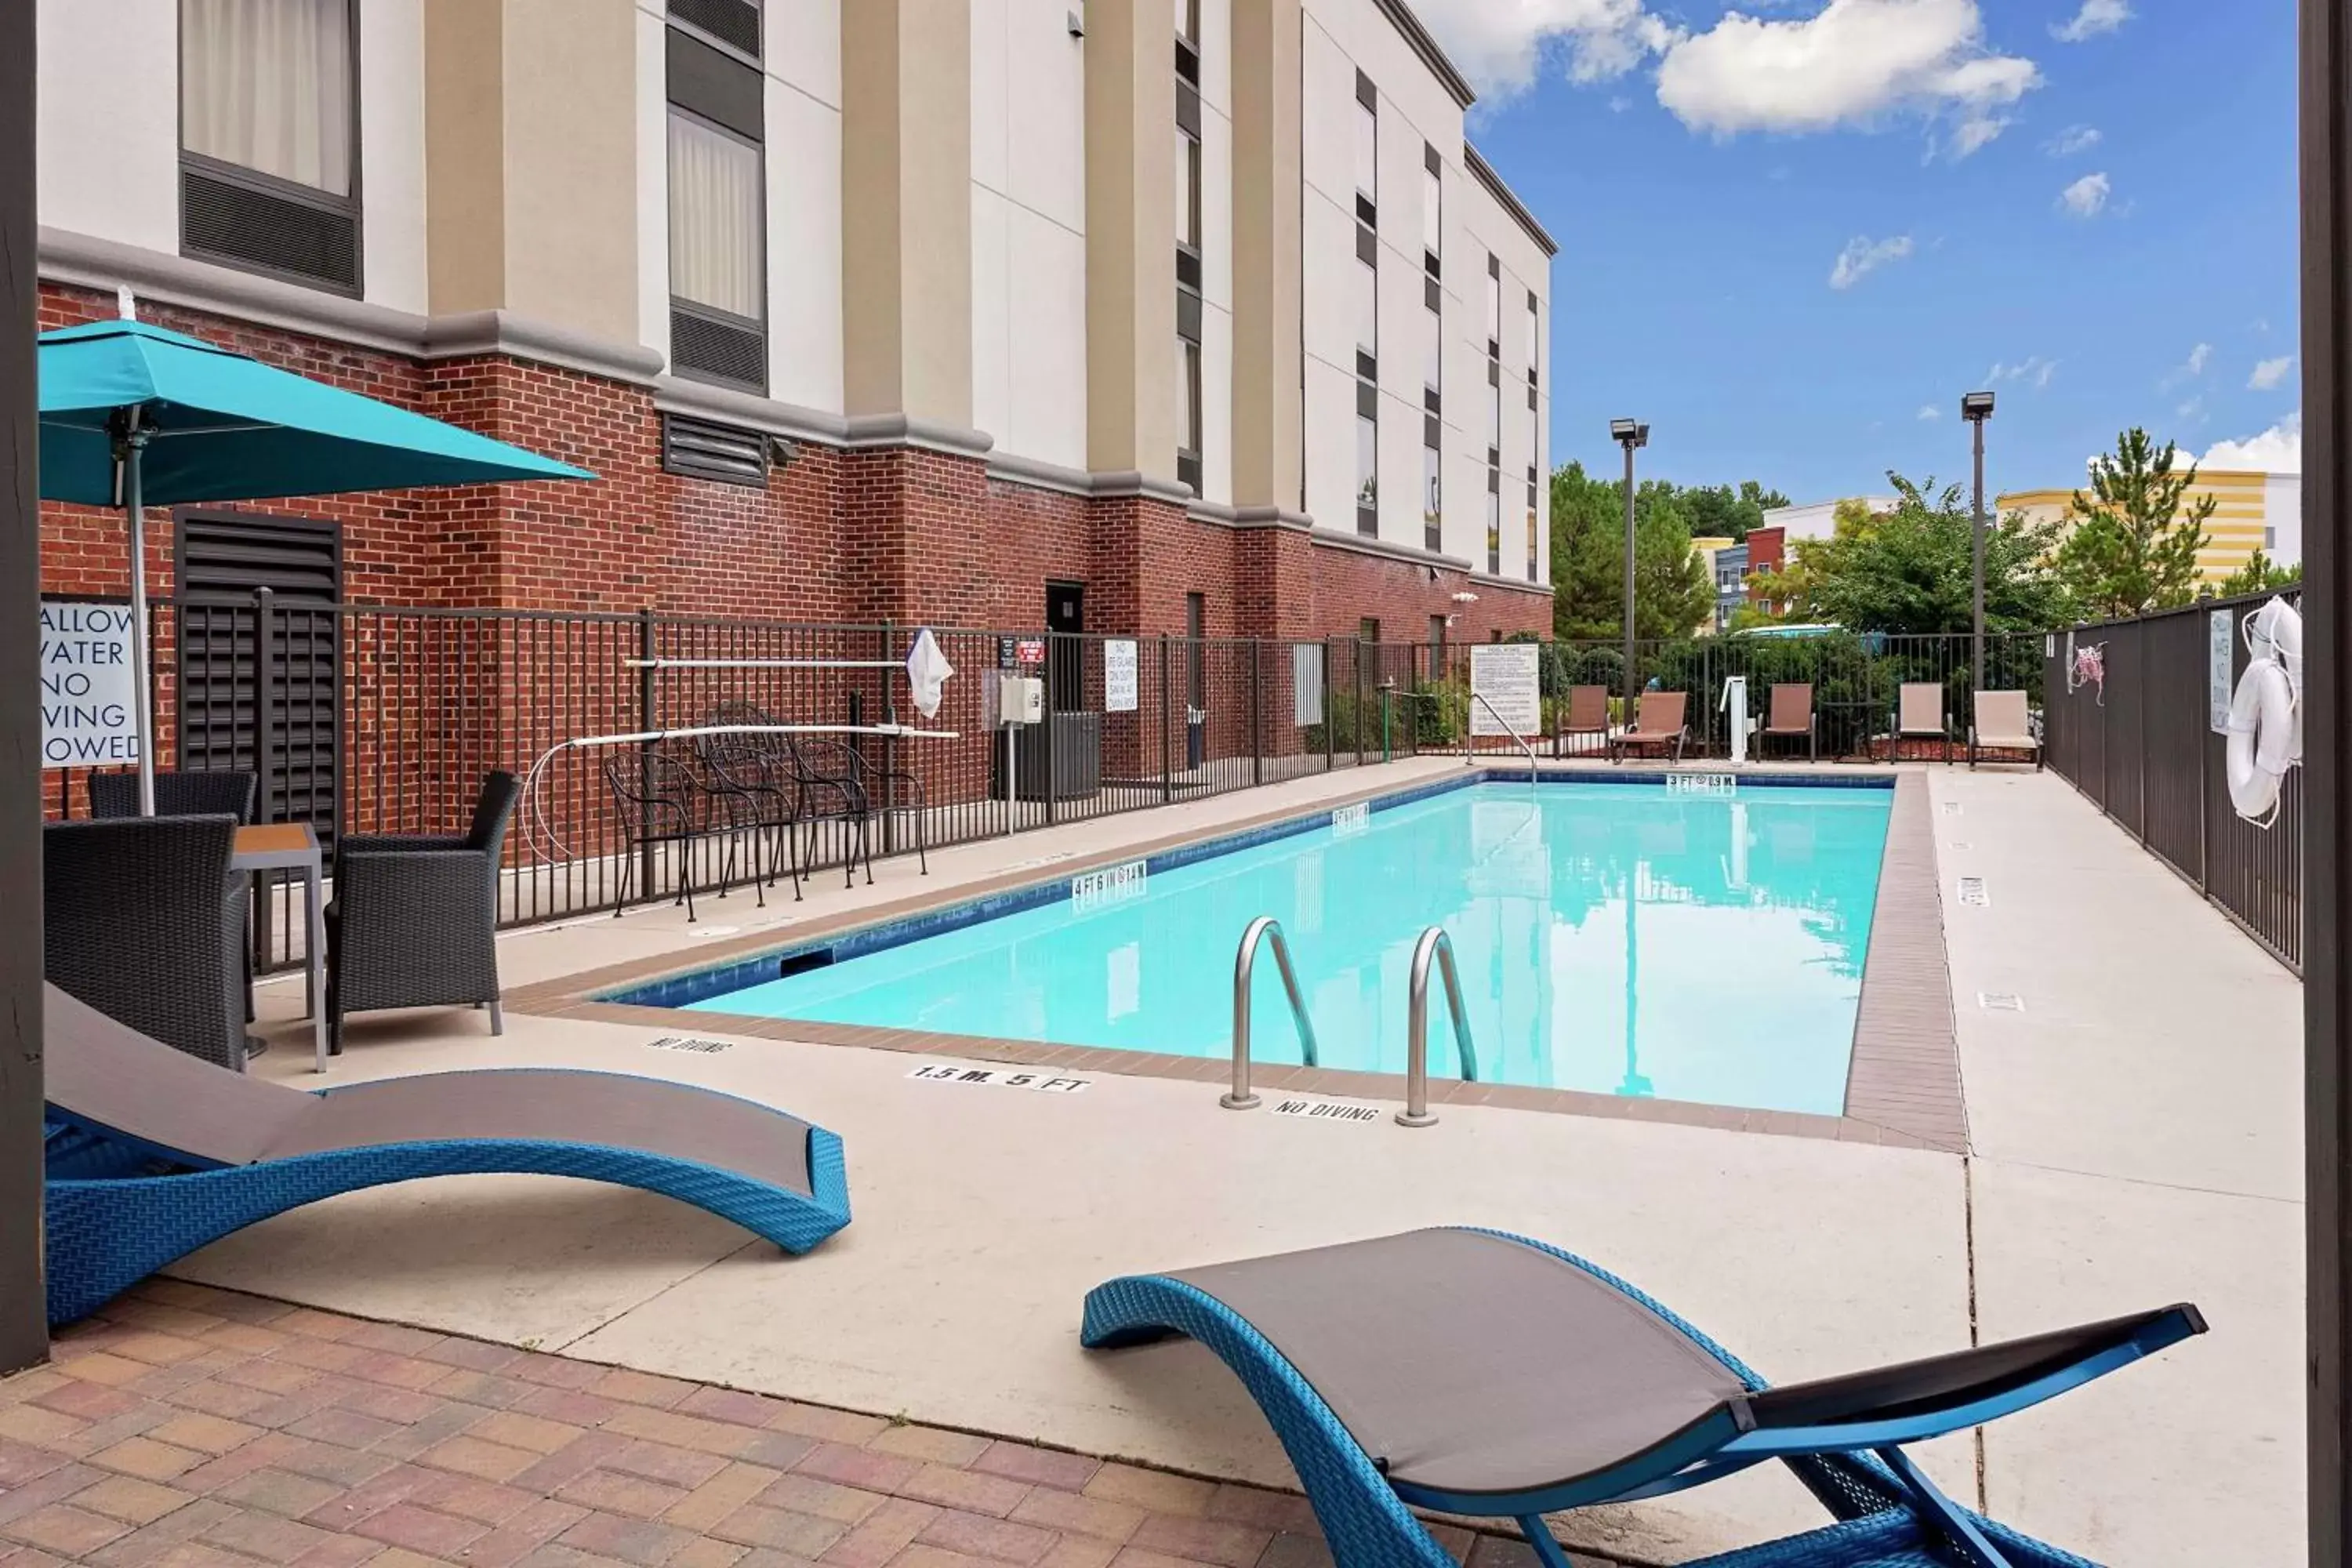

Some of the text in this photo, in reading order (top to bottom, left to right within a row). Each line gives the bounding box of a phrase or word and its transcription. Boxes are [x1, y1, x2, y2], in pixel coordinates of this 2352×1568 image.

[41, 641, 123, 664] ATER
[1670, 776, 1677, 785] 3
[1680, 775, 1693, 785] FT
[1075, 880, 1081, 895] 4
[1085, 877, 1094, 895] FT
[1098, 874, 1103, 890] 6
[648, 1037, 733, 1053] NO DIVING
[916, 1066, 959, 1079] 1.5
[1006, 1075, 1037, 1086] 5
[1040, 1078, 1091, 1091] FT
[1274, 1101, 1380, 1120] NO DIVING
